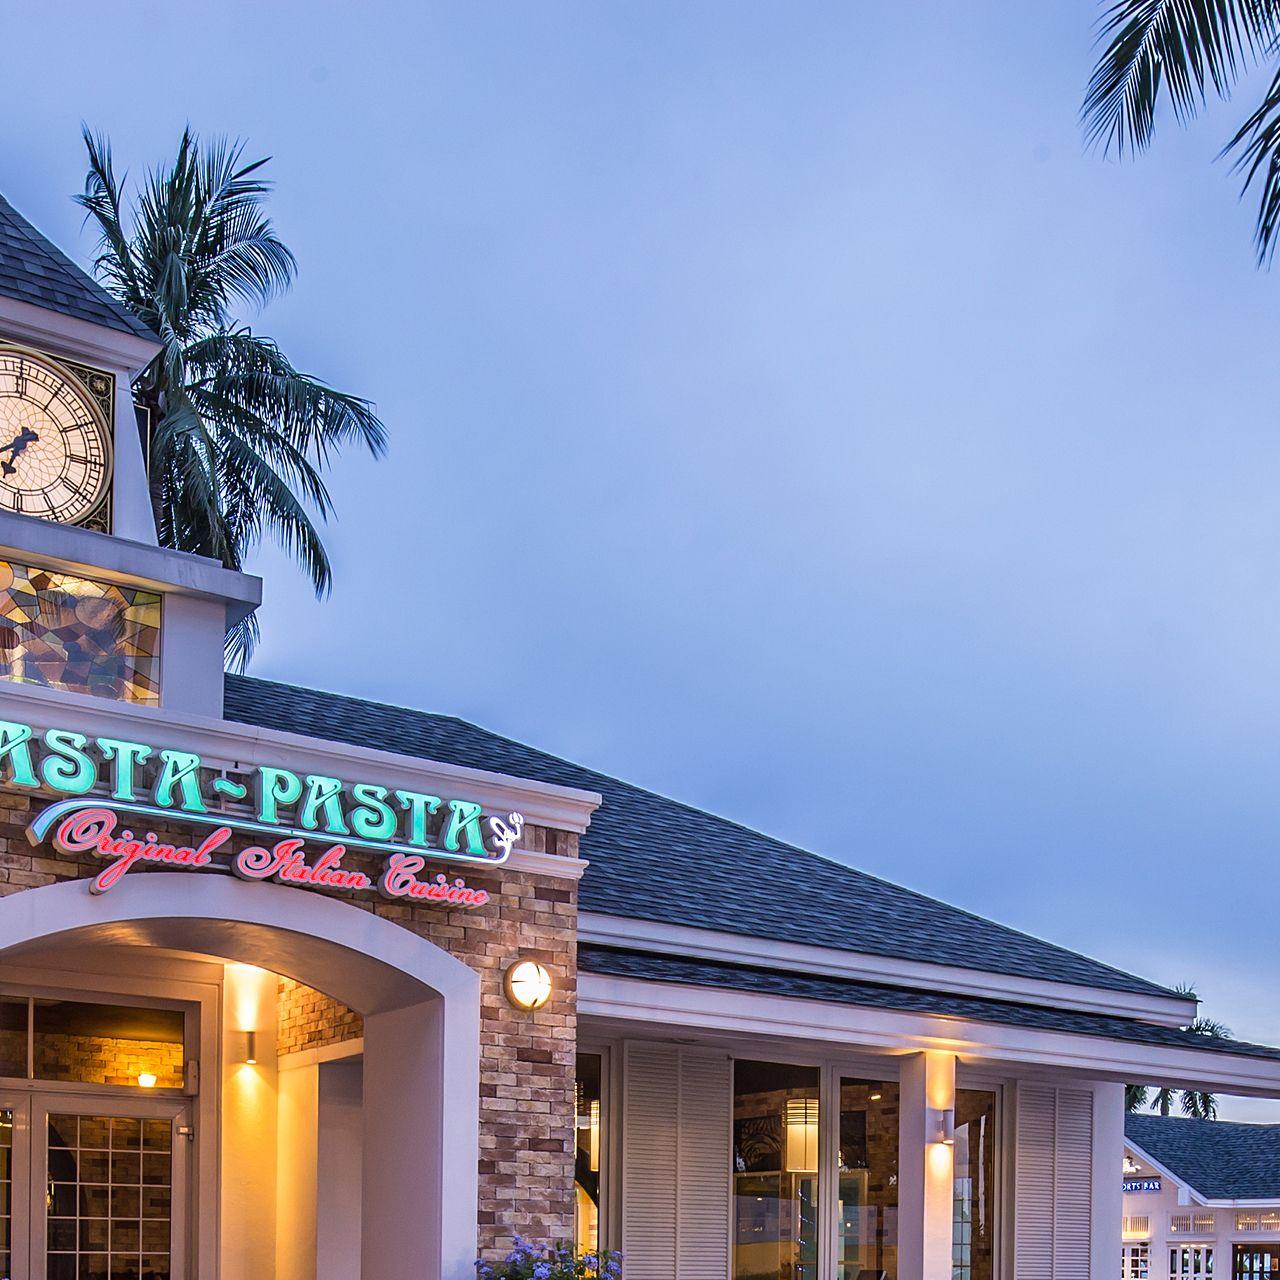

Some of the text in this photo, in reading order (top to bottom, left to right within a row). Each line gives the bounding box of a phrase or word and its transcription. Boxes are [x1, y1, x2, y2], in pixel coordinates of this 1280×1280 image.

[57, 808, 490, 905] Original Italian Cuisine
[1144, 1181, 1160, 1190] BAR
